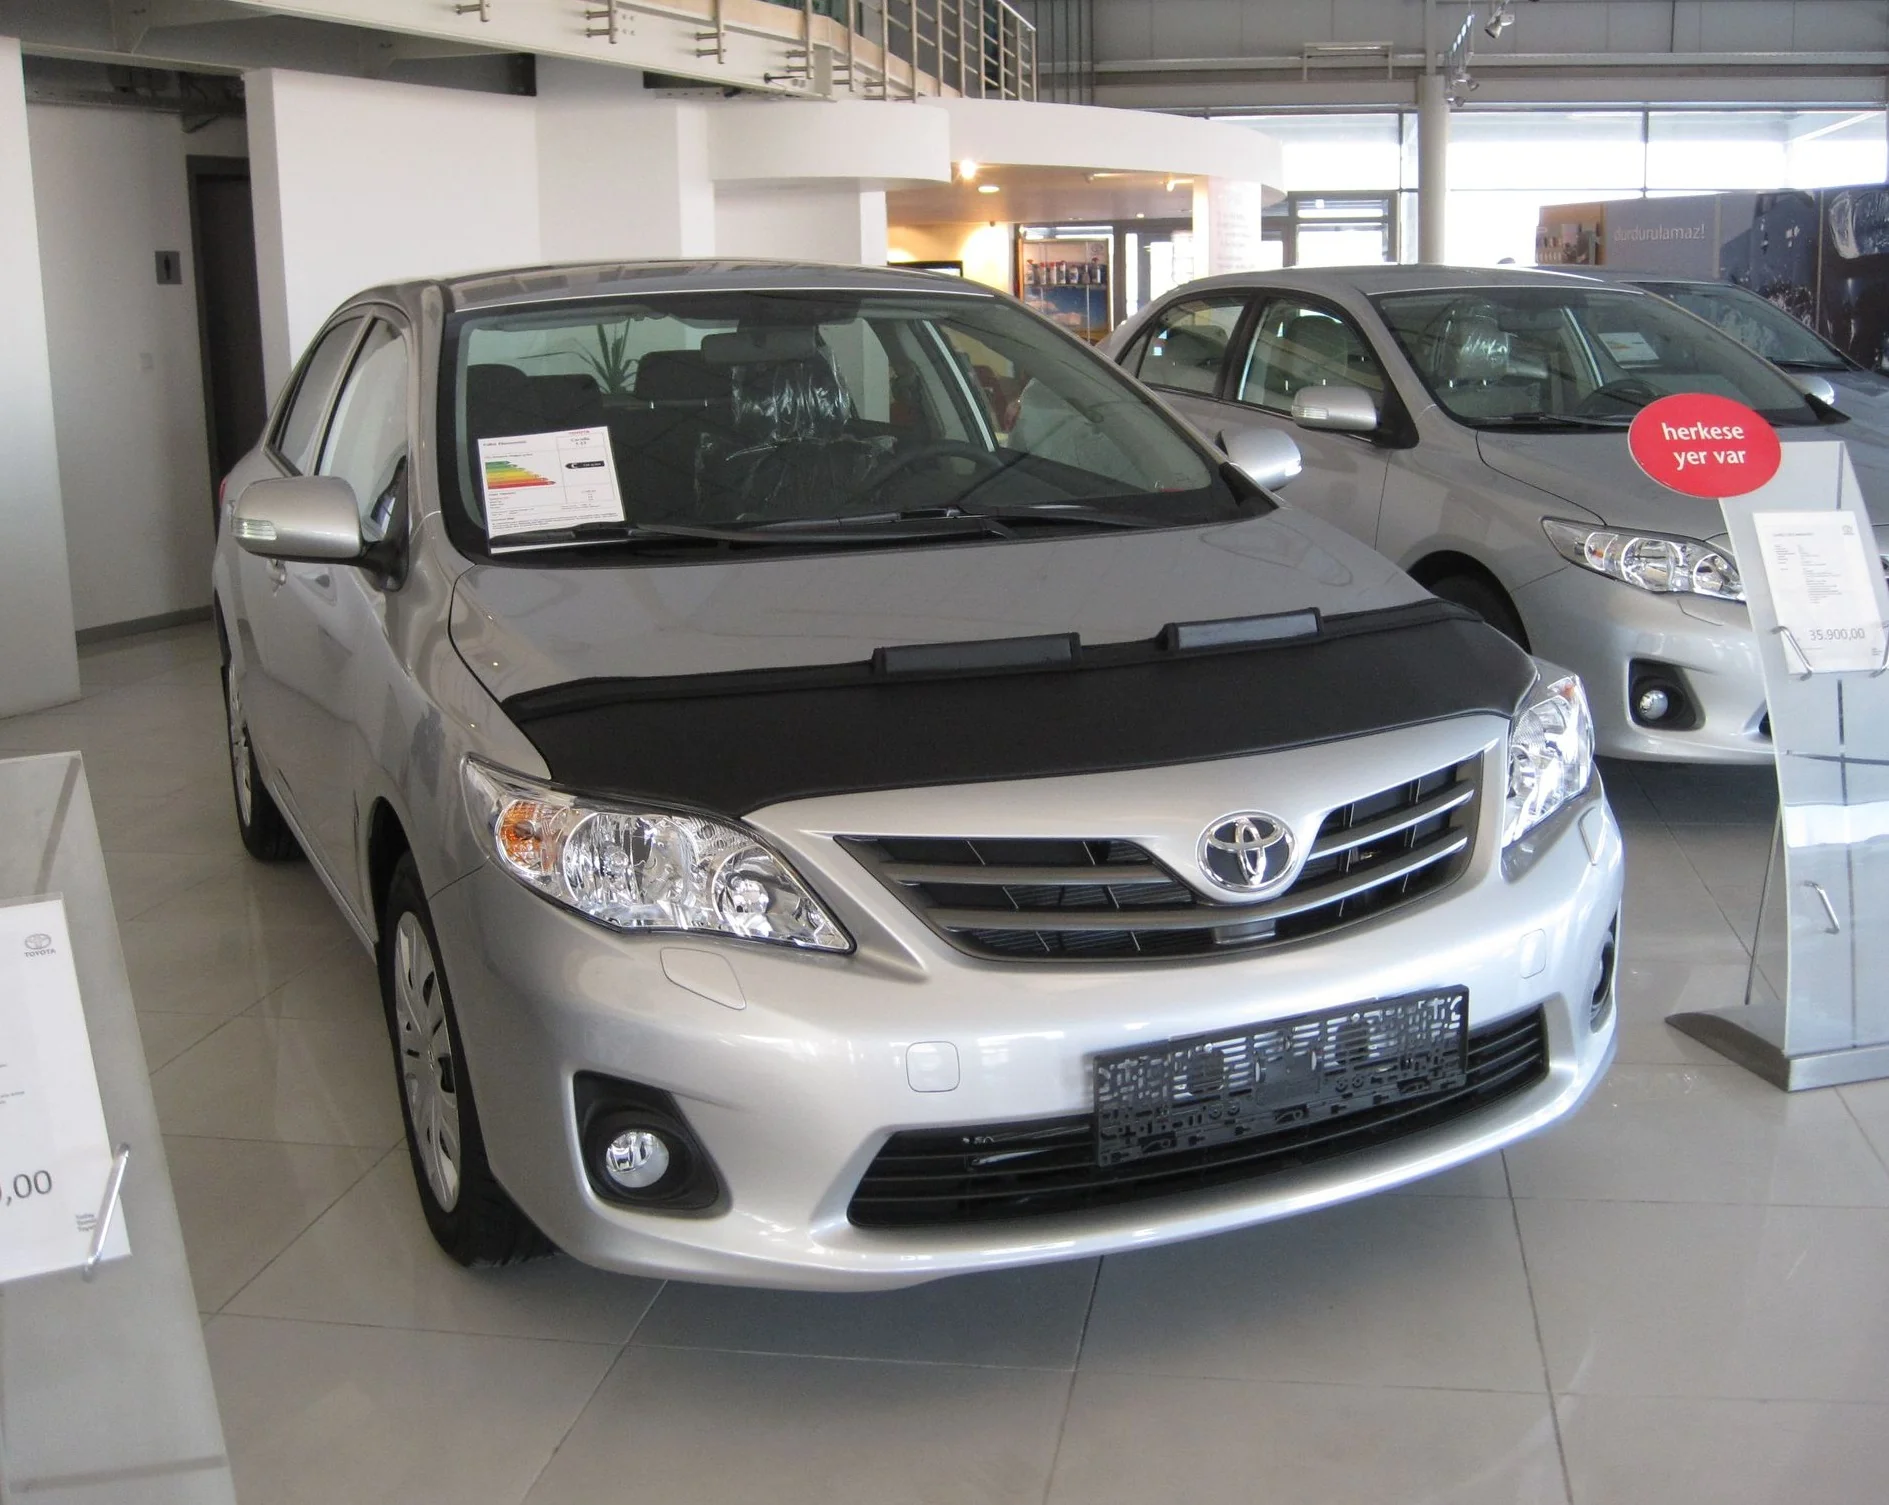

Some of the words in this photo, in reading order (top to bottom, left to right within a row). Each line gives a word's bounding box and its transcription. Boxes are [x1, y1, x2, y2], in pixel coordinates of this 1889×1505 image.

[1661, 421, 1745, 440] herkese
[1673, 451, 1707, 471] yer
[1713, 450, 1746, 464] var
[1809, 627, 1865, 641] 35.900,00
[24, 948, 57, 958] TOYOTA
[0, 1170, 53, 1207] ,00
